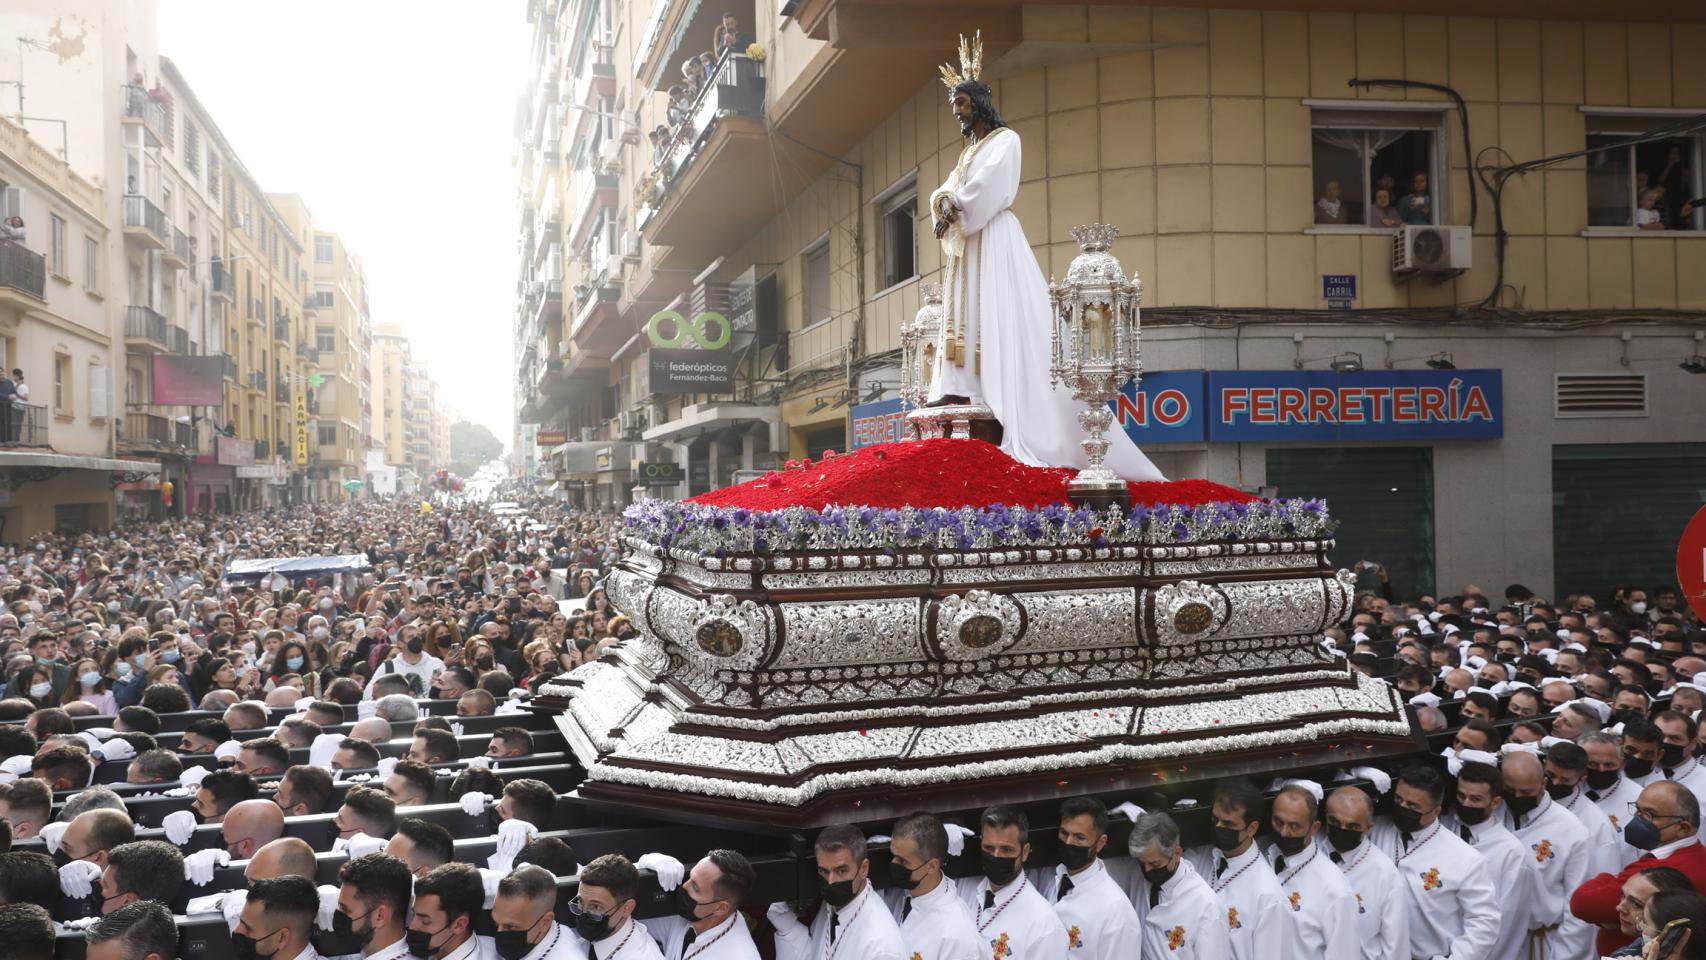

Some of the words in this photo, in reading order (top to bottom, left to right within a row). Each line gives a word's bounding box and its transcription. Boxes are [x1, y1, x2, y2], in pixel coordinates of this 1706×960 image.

[669, 362, 727, 373] federópticos
[1221, 377, 1494, 425] FERRETERÍA
[297, 396, 306, 459] FARMACIA
